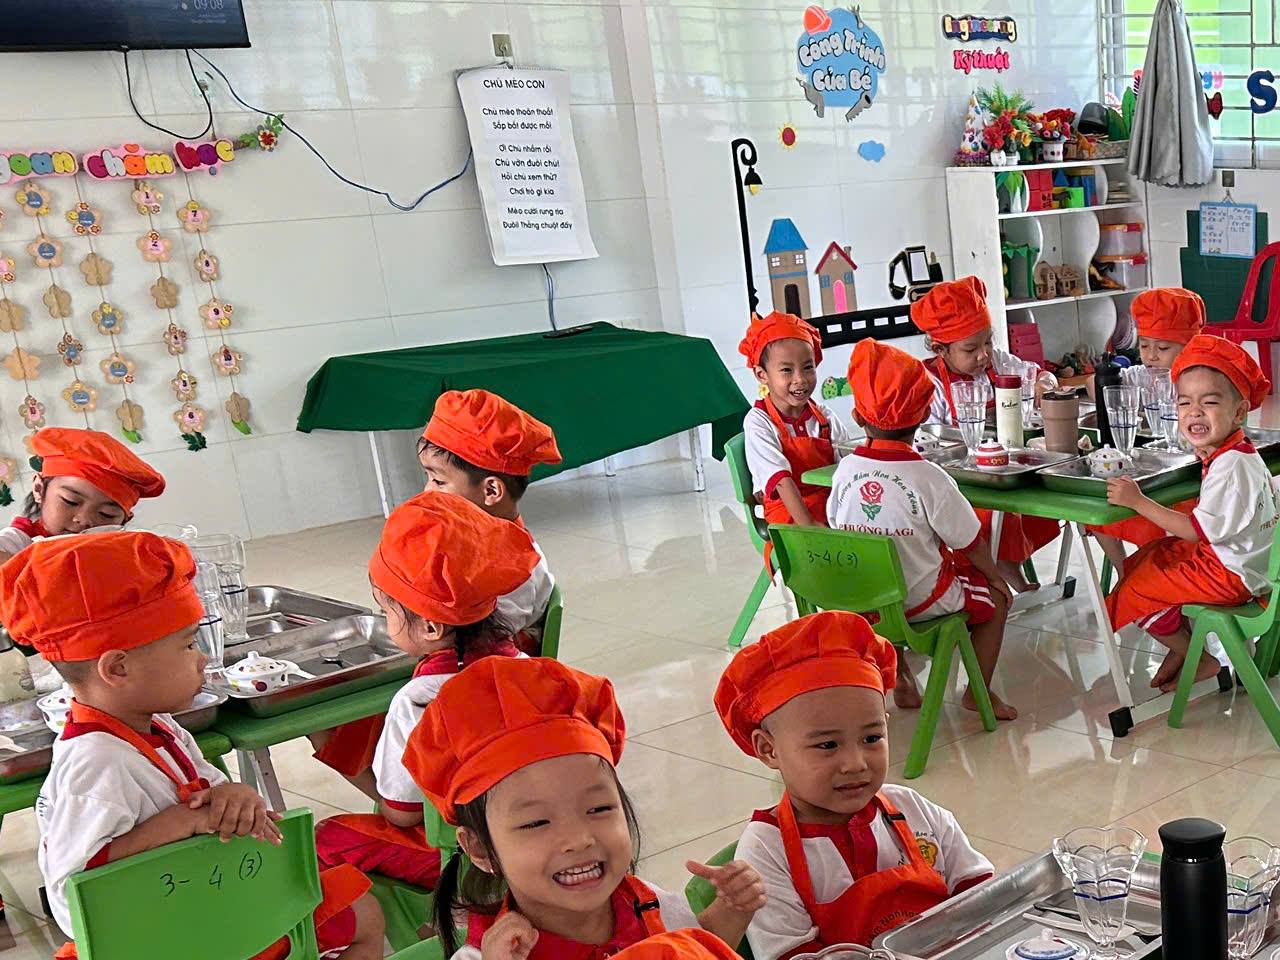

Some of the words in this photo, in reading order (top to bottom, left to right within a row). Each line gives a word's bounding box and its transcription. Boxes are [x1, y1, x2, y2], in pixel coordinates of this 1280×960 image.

[798, 36, 843, 67] Công
[843, 28, 885, 70] Trình
[972, 46, 1010, 74] thuật
[525, 79, 545, 89] CON
[812, 66, 847, 91] Của
[848, 66, 872, 91] Bé
[191, 210, 198, 218] 7
